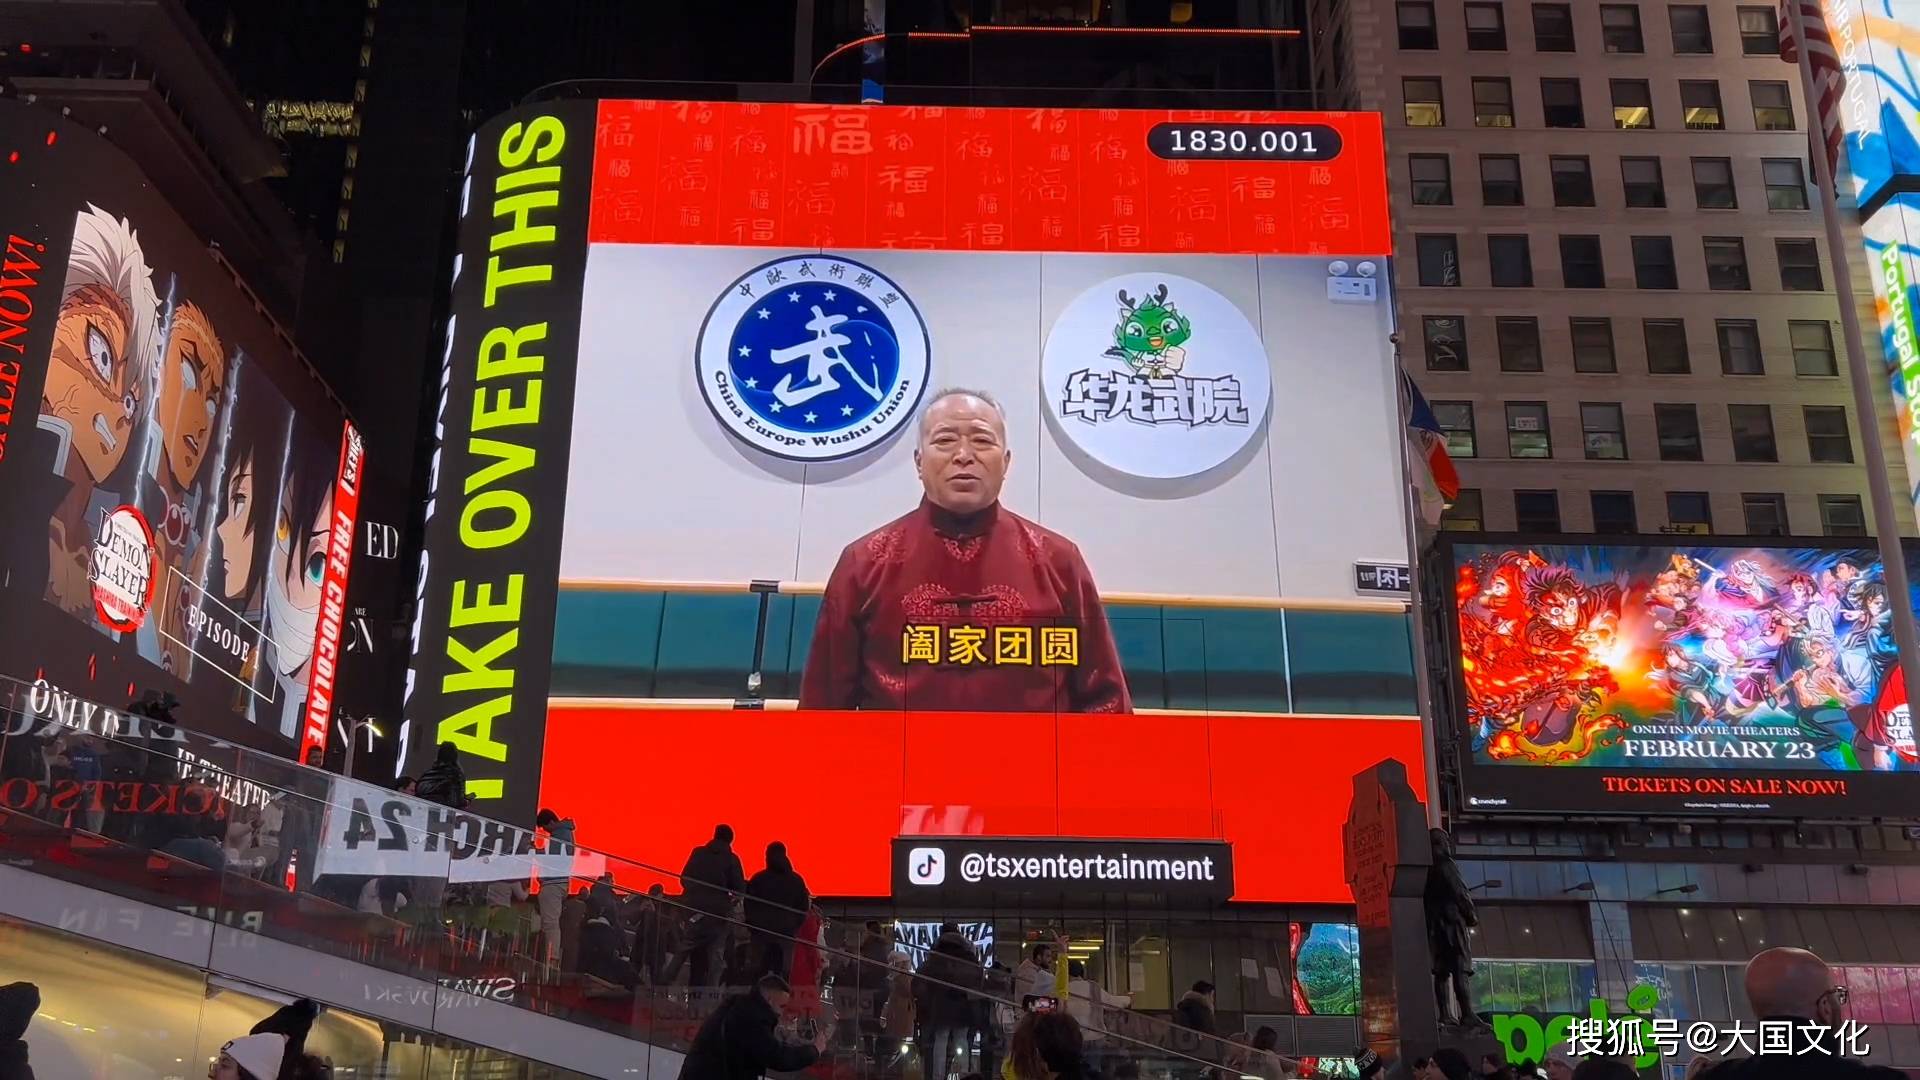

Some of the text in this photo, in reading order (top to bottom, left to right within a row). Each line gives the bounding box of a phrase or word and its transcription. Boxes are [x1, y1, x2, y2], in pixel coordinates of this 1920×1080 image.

[1170, 130, 1318, 153] 1830.001
[484, 115, 565, 308] THIS
[1881, 244, 1919, 371] Portugal
[715, 370, 911, 447] China Europe Wushu Union
[1061, 369, 1250, 428] 华龙武院
[459, 322, 548, 549] OVER
[96, 508, 152, 572] DEMON
[329, 510, 353, 580] FREE
[90, 547, 148, 612] SLAYER
[187, 604, 250, 662] EPISODE
[307, 579, 343, 746] CHOCOLATE
[902, 624, 1079, 667] 阖家团圆
[1623, 739, 1817, 759] FEBRUARY 23
[1632, 725, 1801, 737] ONLY IN MOVIE THEATERS
[1602, 776, 1847, 796] TICKETS ON SALE NOW!
[960, 852, 1214, 882] @tsxentertainment
